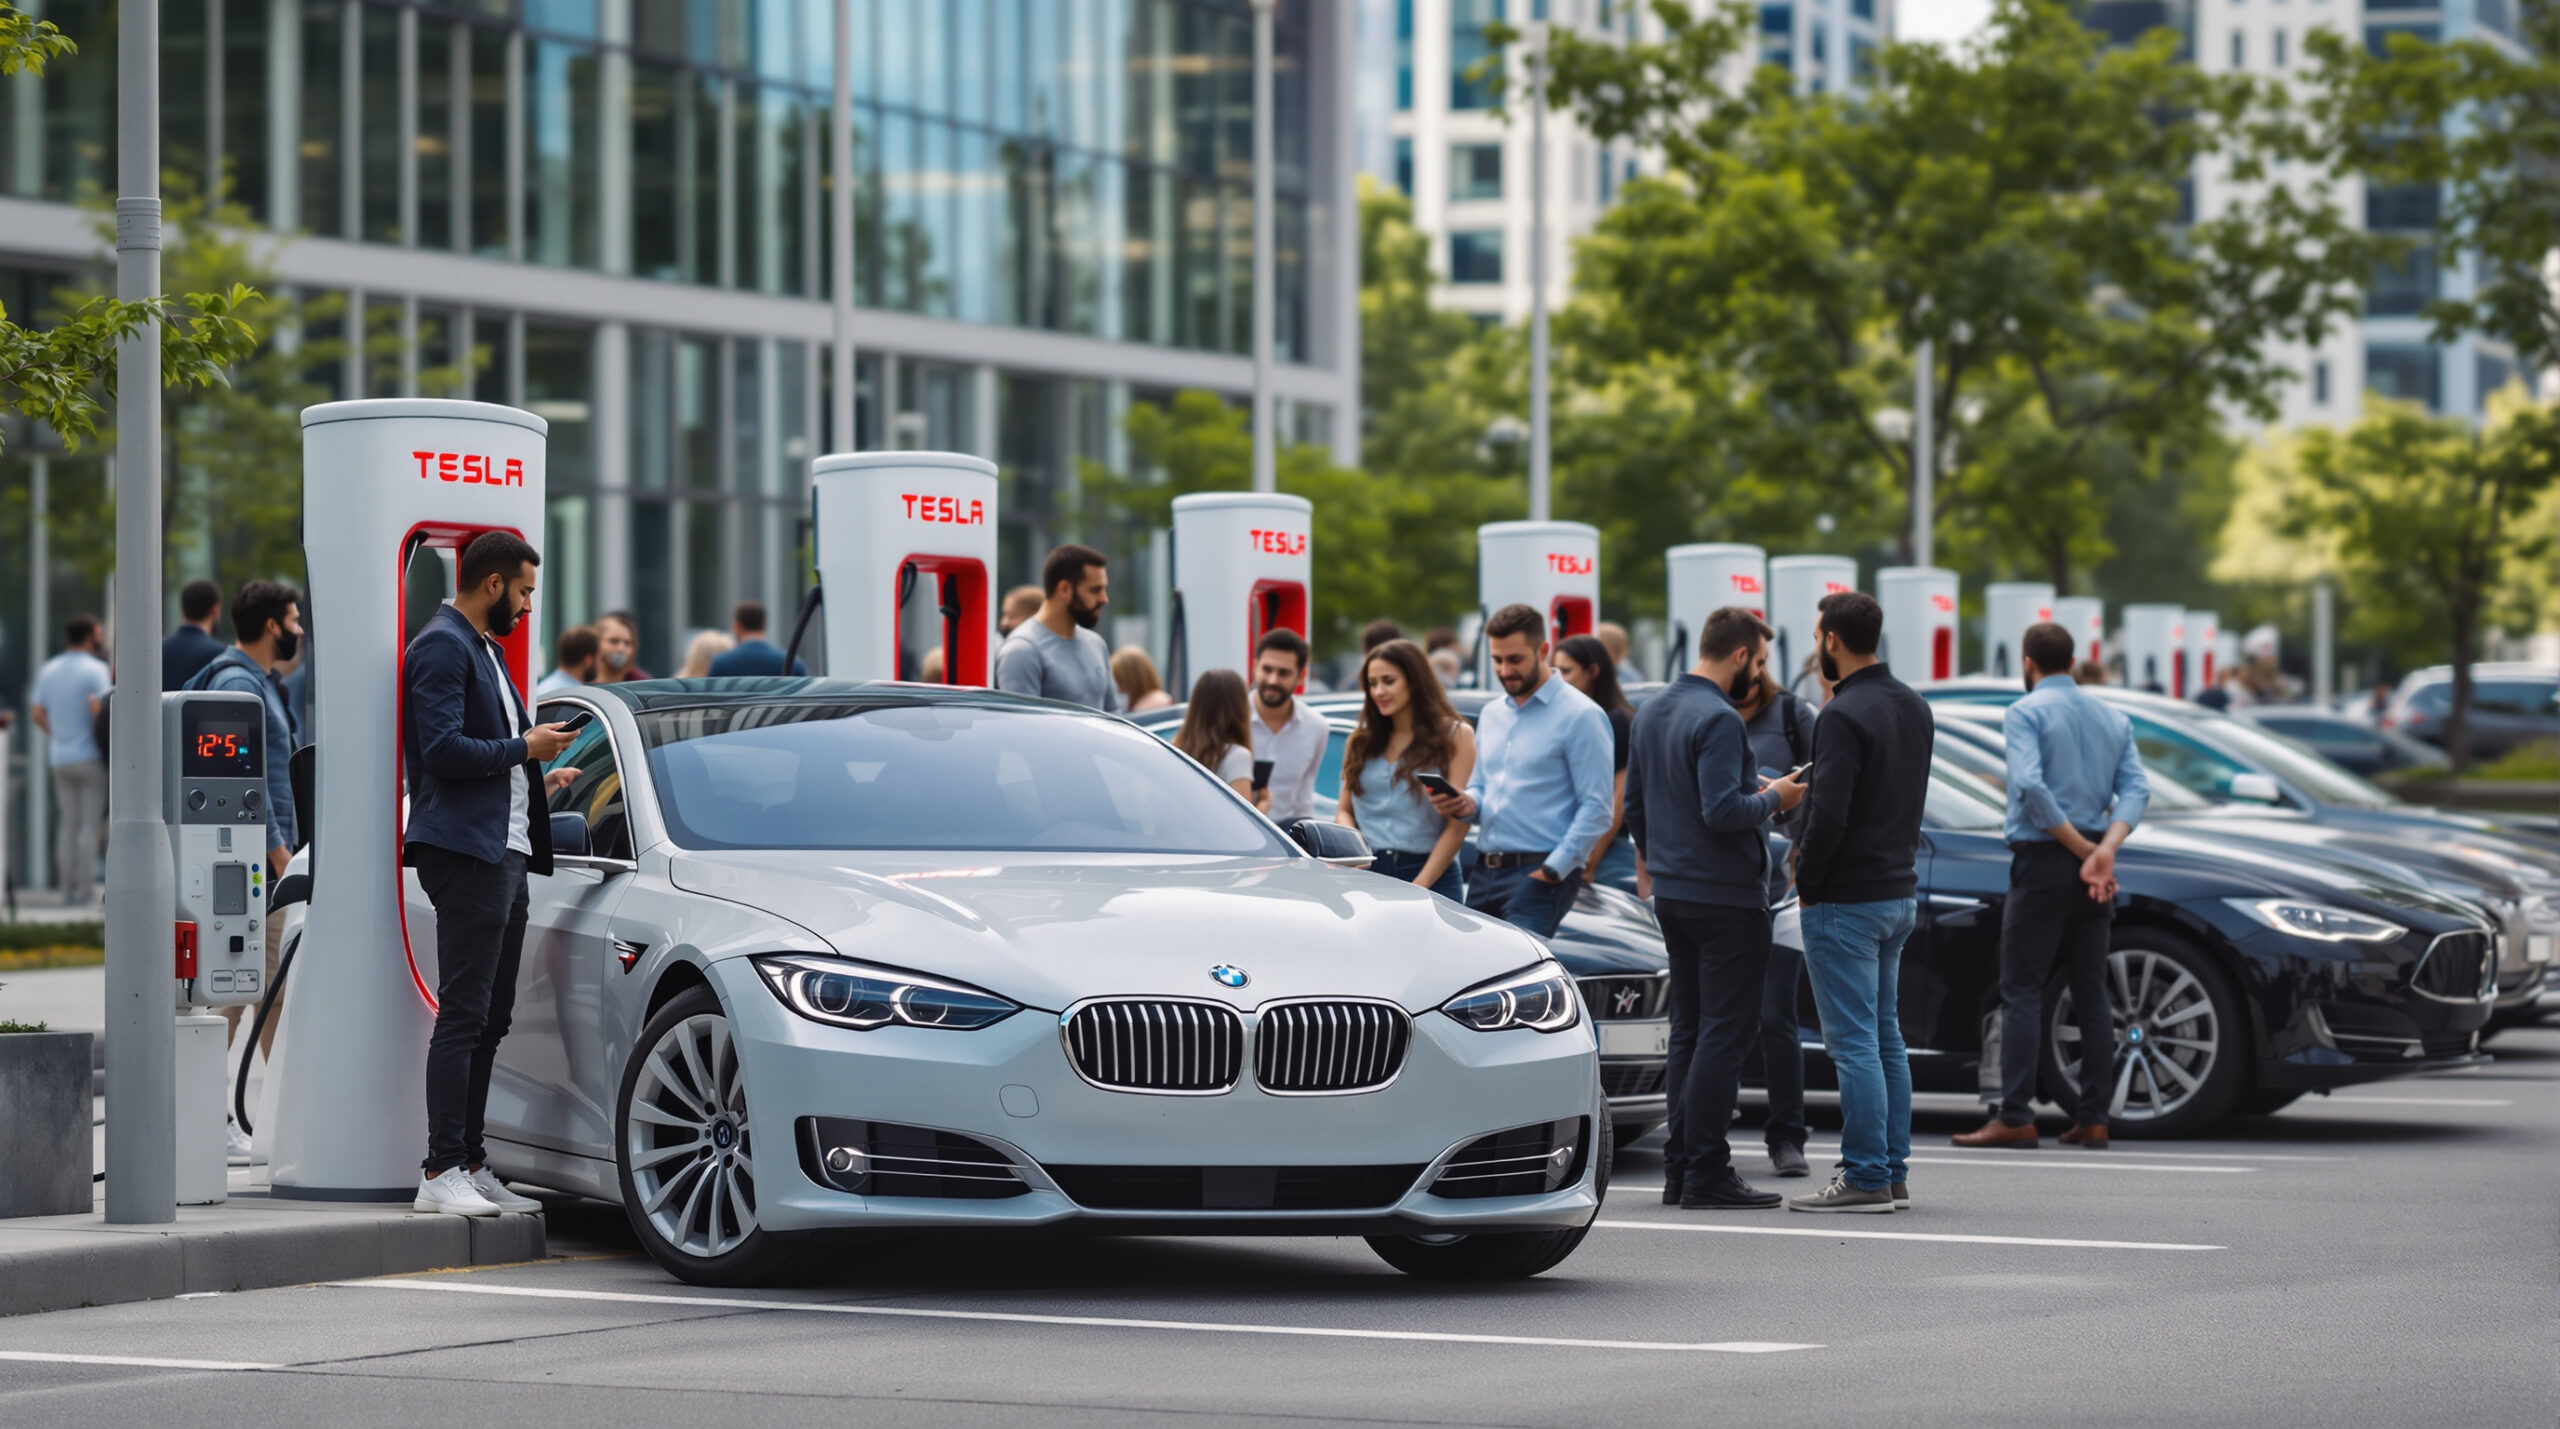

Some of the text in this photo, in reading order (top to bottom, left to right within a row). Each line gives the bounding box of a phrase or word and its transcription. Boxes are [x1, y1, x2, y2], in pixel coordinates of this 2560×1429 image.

[412, 450, 524, 488] TESLA
[901, 493, 985, 525] TESLA
[1249, 528, 1307, 556] TESLA
